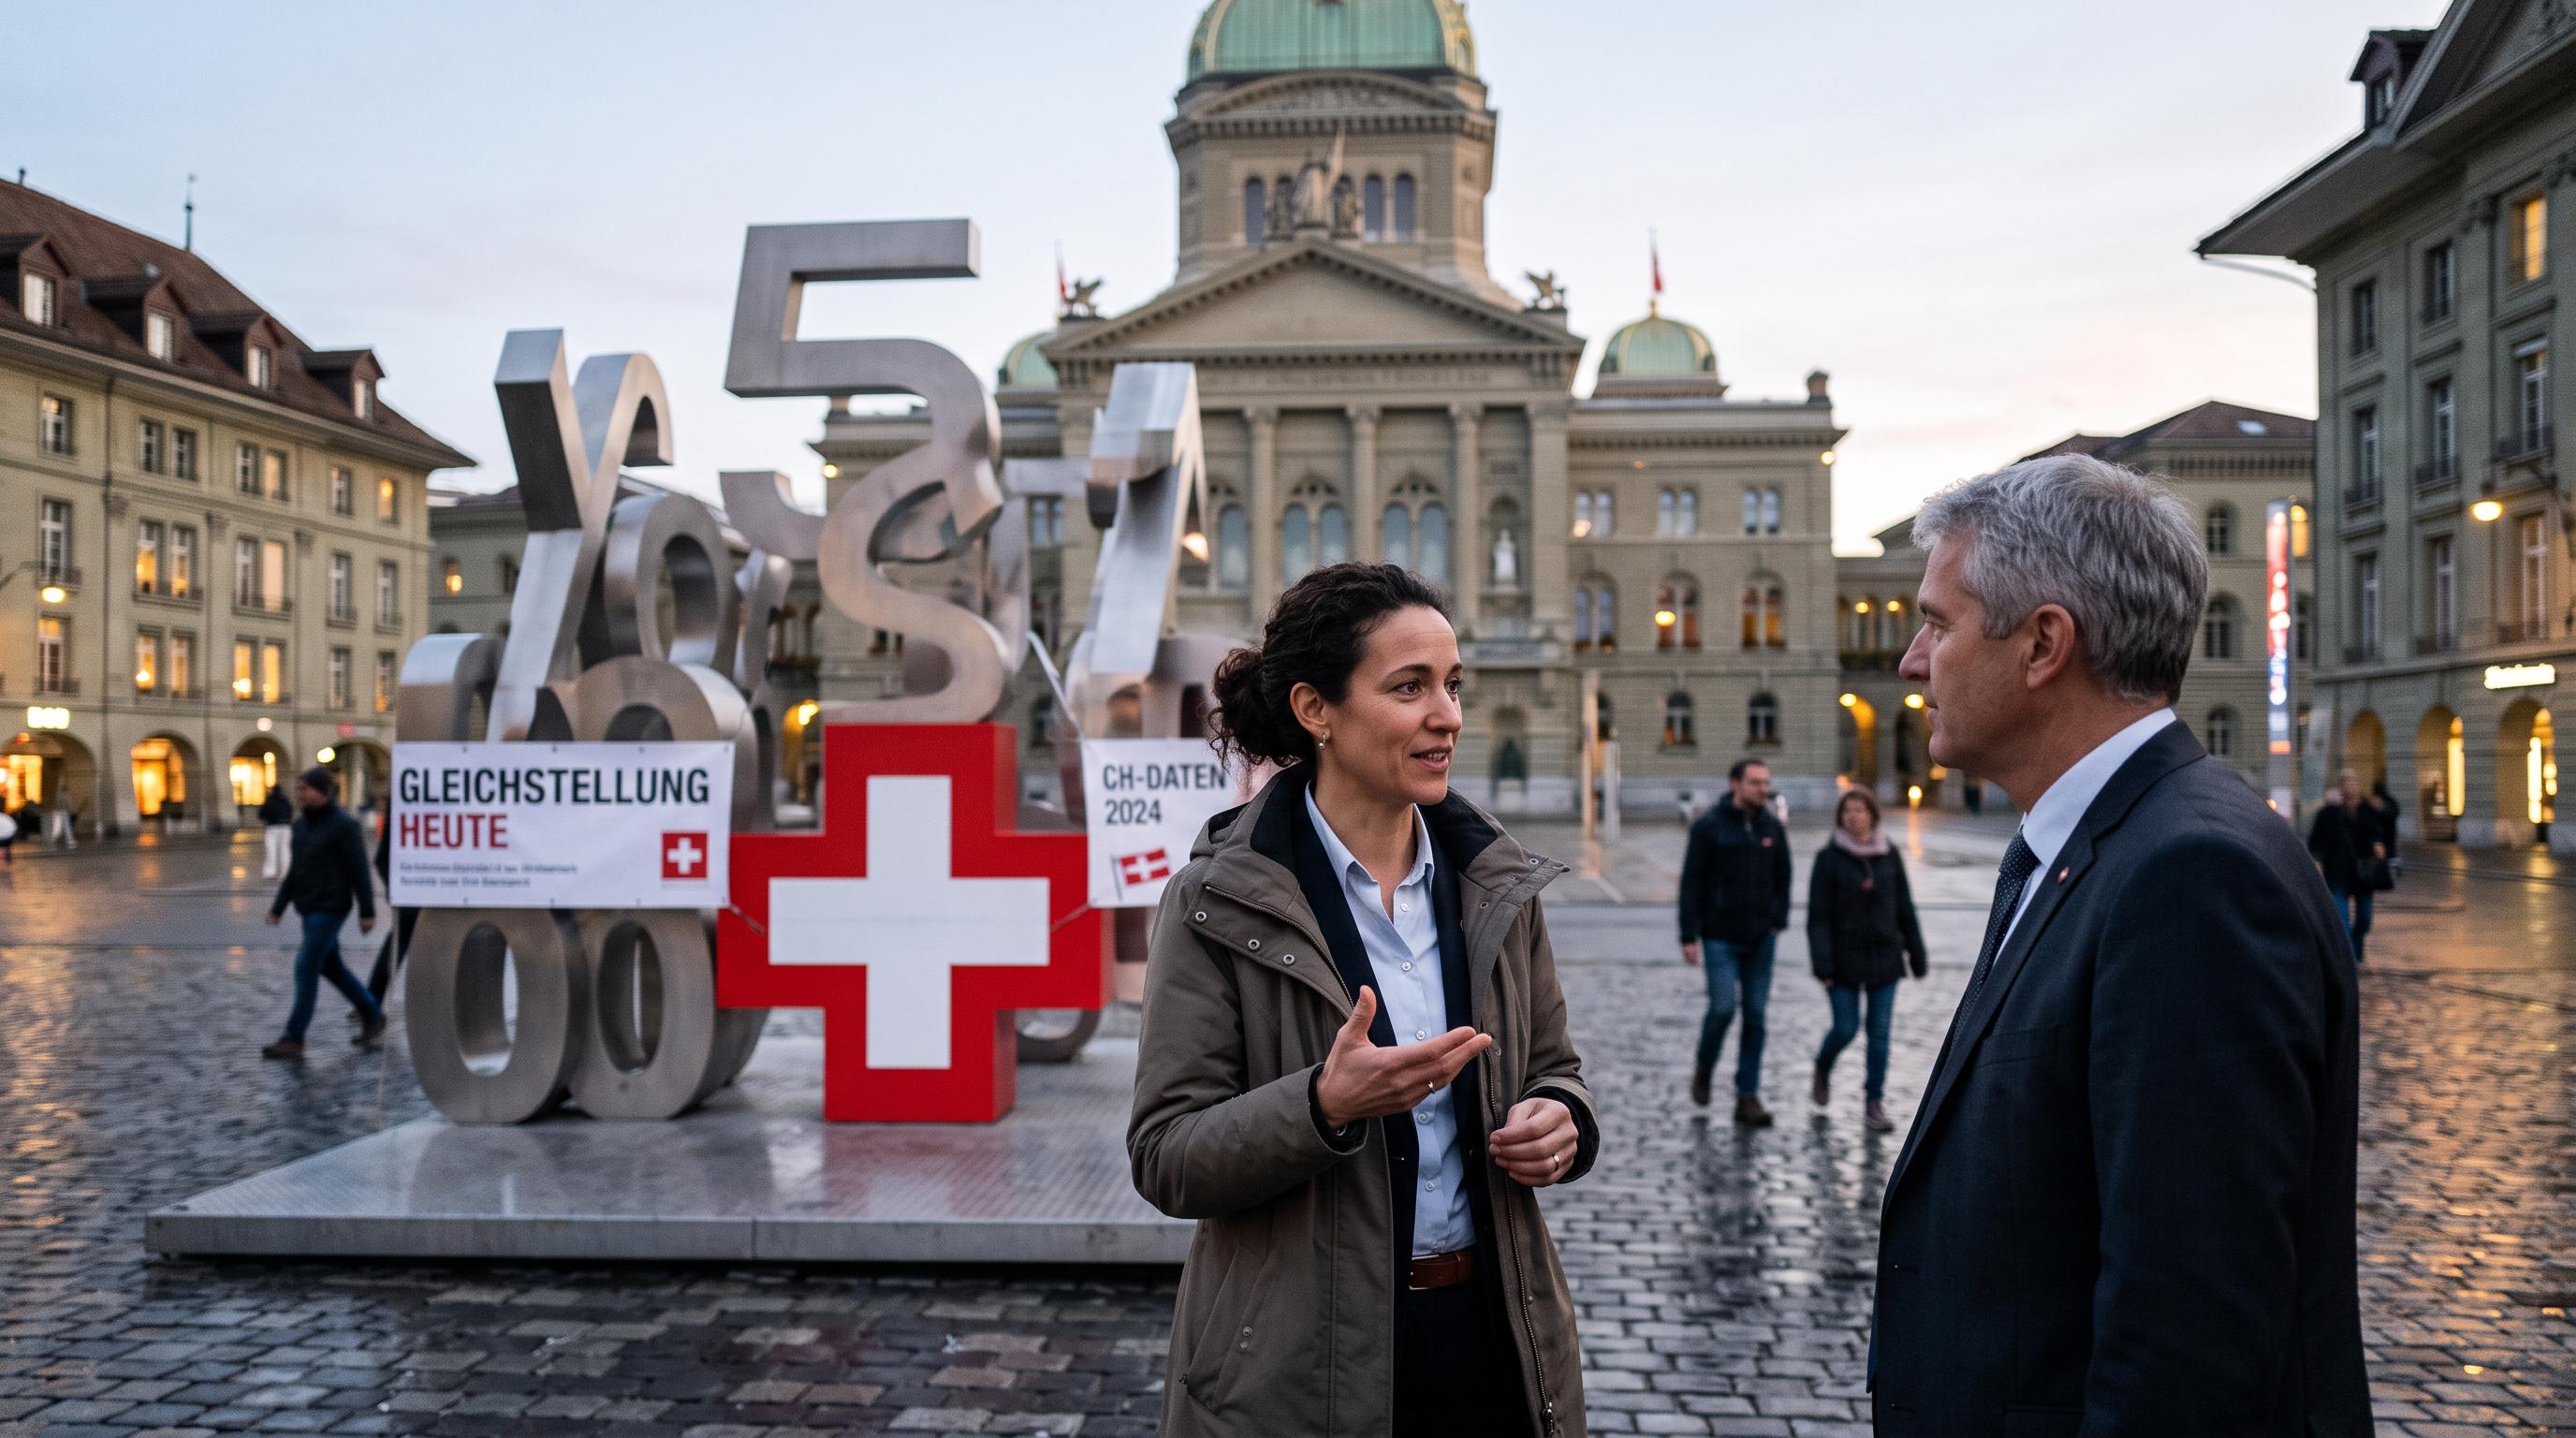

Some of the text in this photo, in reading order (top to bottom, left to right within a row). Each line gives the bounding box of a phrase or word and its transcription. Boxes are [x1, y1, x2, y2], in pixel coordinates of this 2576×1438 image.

[400, 768, 709, 804] GLEICHSTELLUNG
[1103, 764, 1227, 789] CH-DATEN
[1105, 800, 1162, 825] 2024
[400, 813, 508, 848] HEUTE
